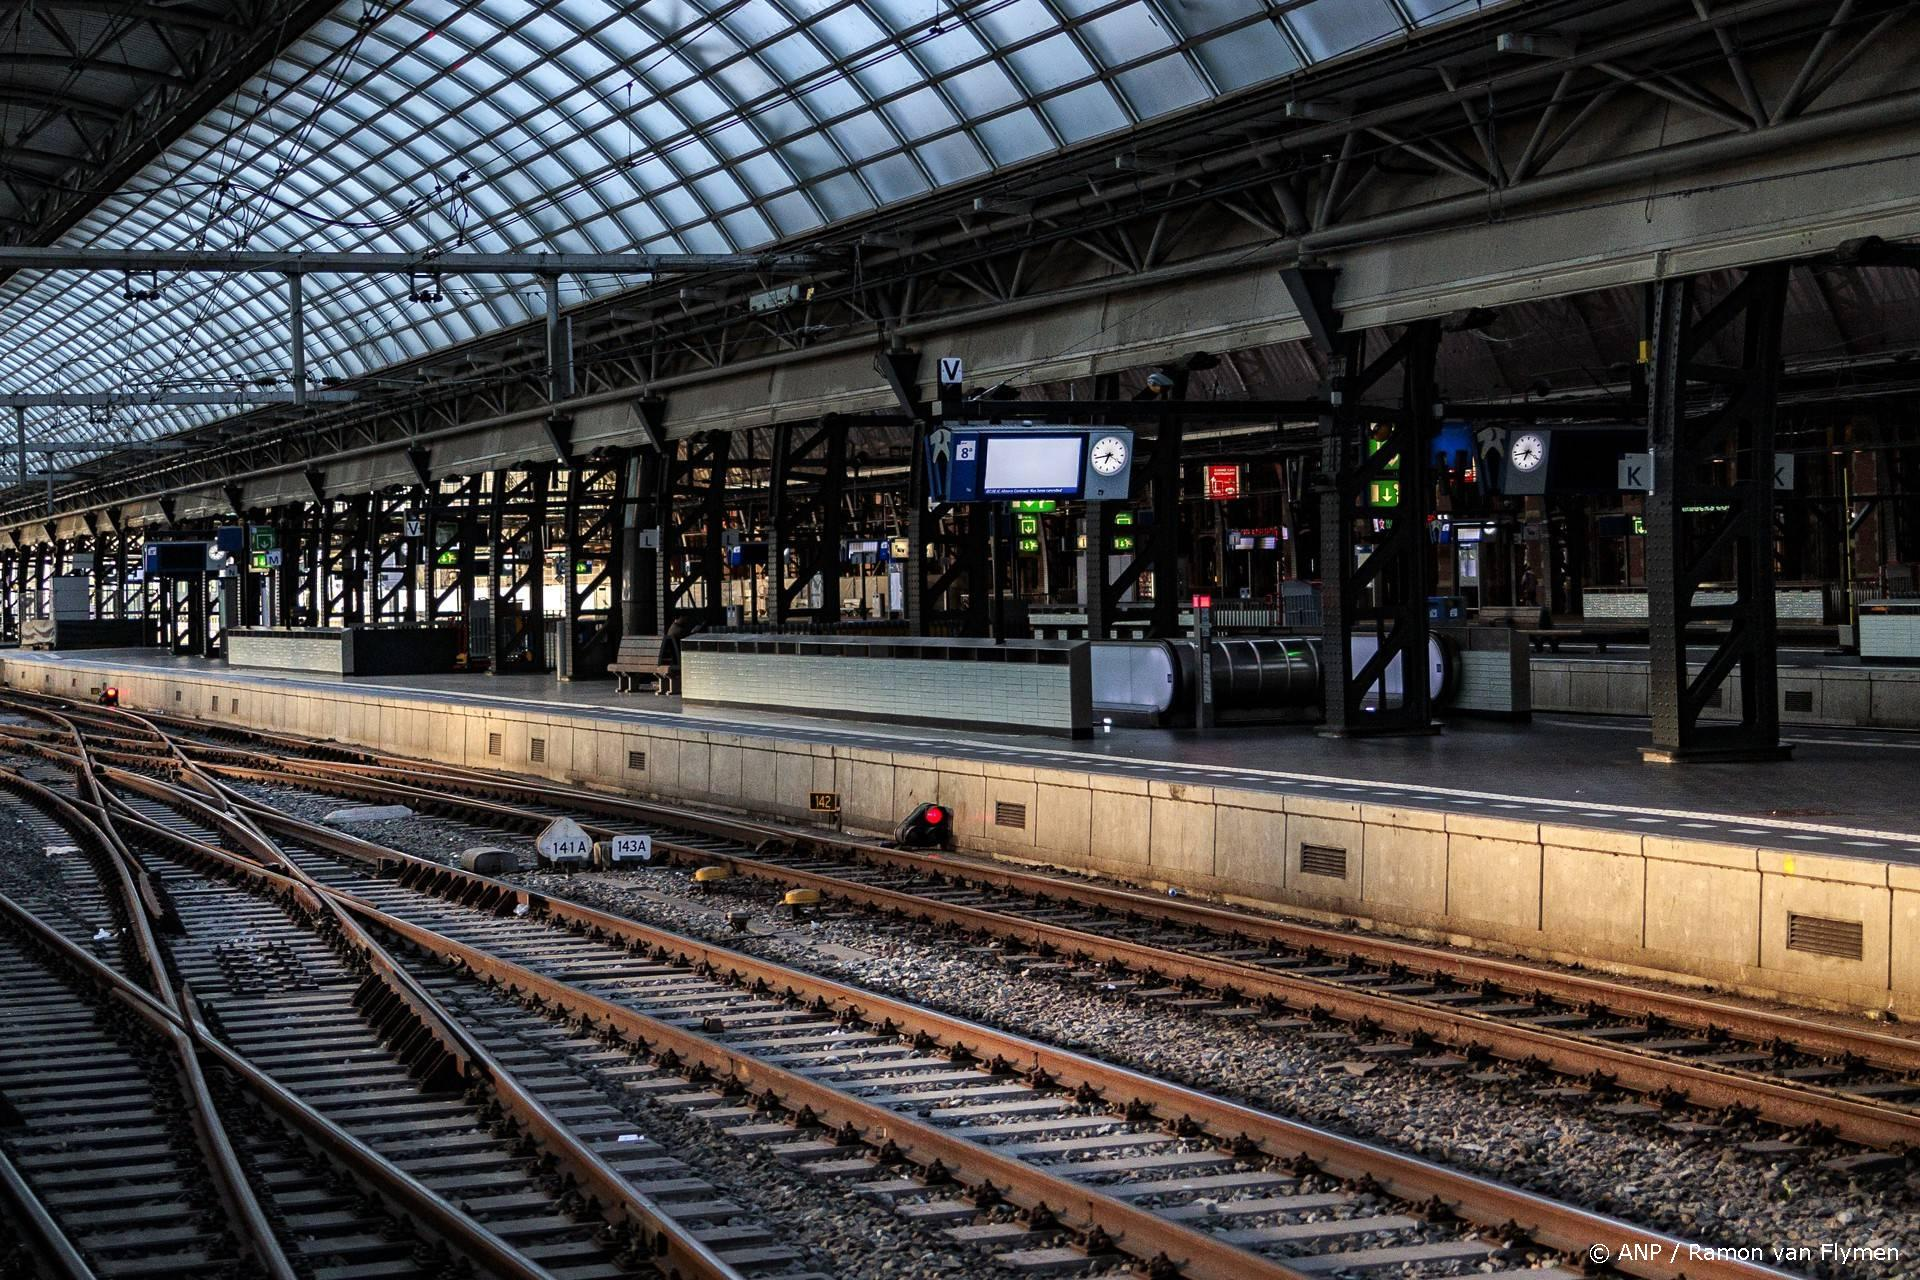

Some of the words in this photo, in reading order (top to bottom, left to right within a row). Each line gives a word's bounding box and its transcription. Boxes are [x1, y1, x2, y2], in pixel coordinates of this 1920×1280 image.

[943, 360, 960, 380] V
[1628, 466, 1642, 486] K
[408, 522, 419, 535] V
[646, 535, 652, 546] L
[269, 556, 279, 564] M
[816, 795, 831, 808] 142
[618, 840, 646, 853] 143A
